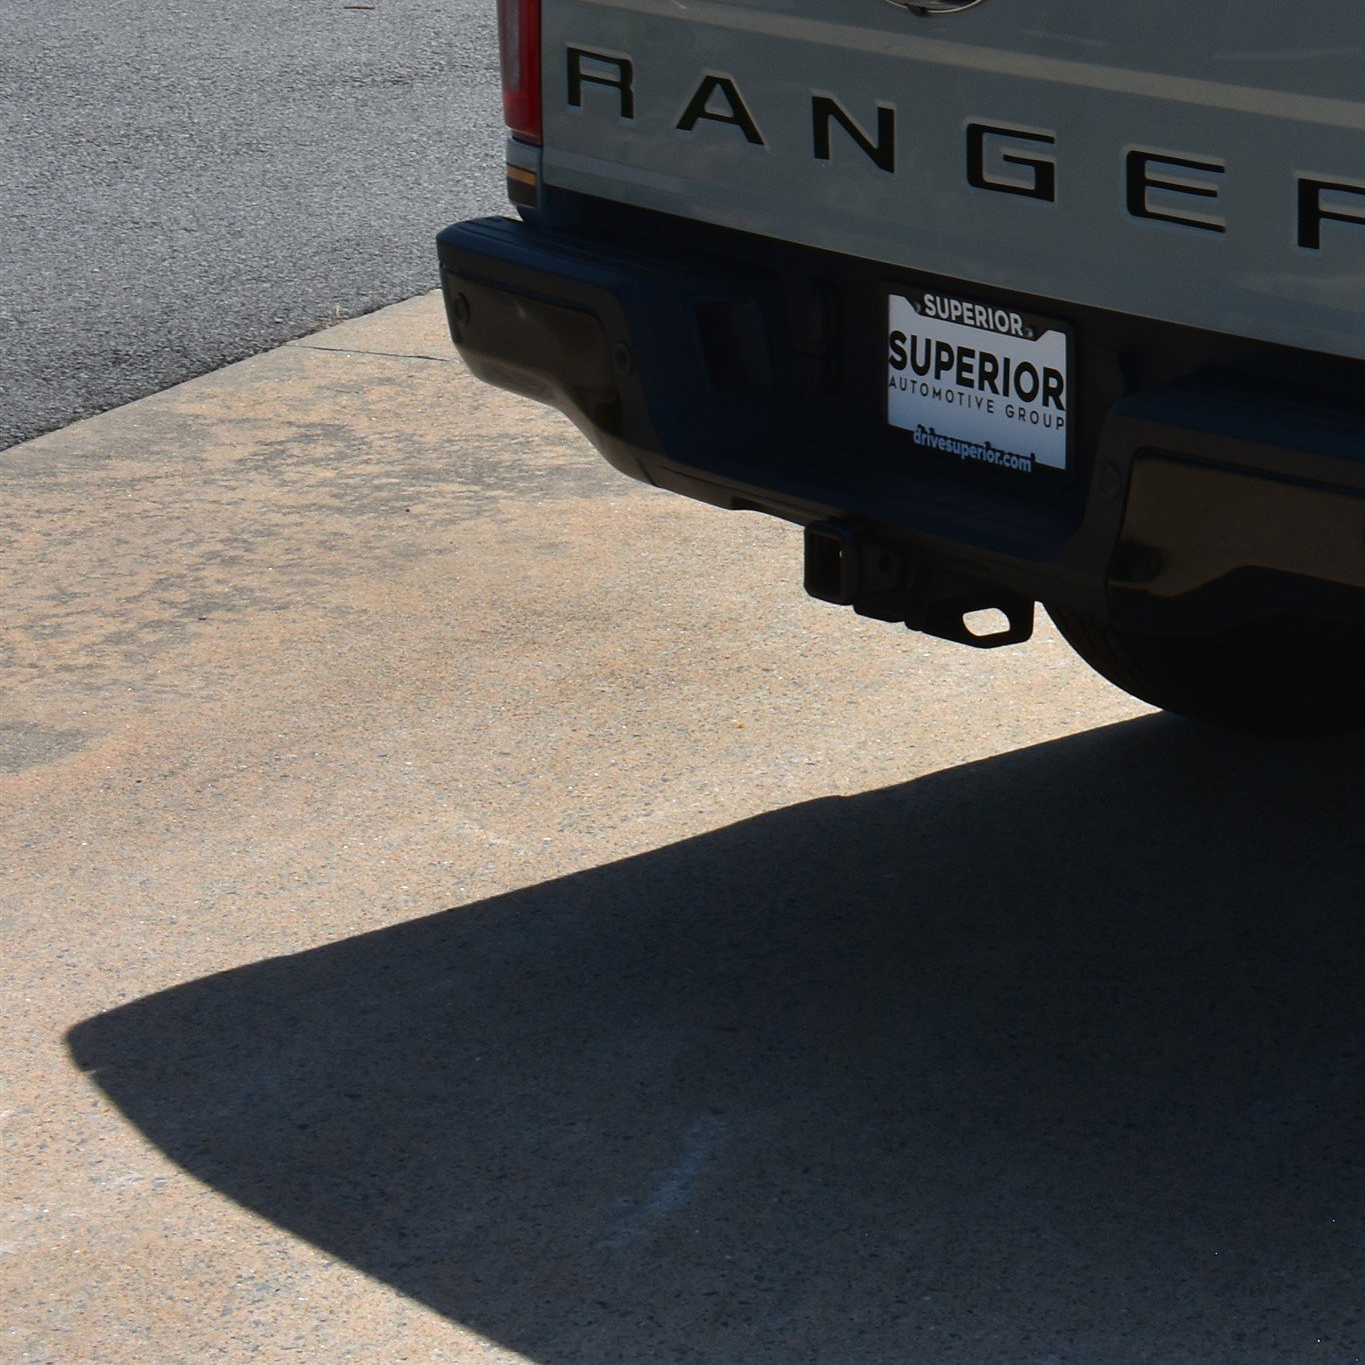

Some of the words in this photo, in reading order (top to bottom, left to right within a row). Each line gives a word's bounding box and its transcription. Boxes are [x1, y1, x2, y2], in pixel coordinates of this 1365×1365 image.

[923, 293, 1024, 336] SUPERIOR
[888, 330, 1065, 411] SUPERIOR
[889, 375, 995, 414] AUTOMOTIVE
[1005, 404, 1065, 431] GROUP
[912, 426, 1032, 473] drivesuperior.com
